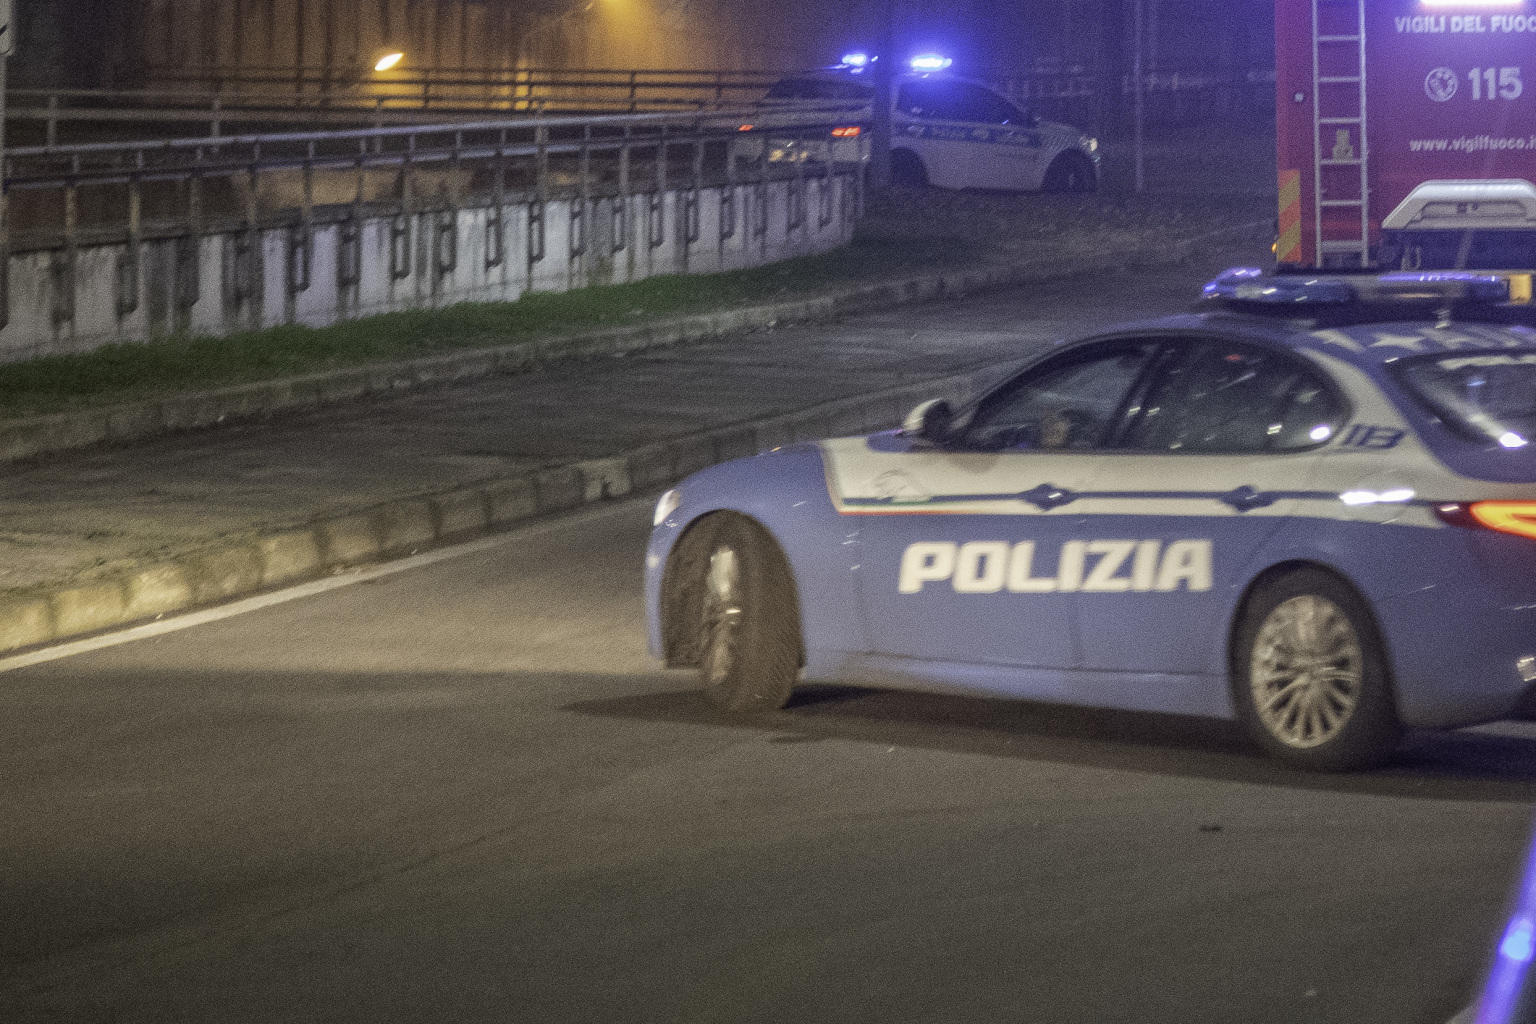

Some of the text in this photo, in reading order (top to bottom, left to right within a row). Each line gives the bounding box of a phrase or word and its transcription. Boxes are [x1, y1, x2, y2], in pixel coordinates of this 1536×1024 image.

[1394, 15, 1446, 33] VIGILI
[1450, 15, 1486, 33] DEL
[1467, 66, 1523, 101] 115
[898, 539, 1214, 593] POLIZIA
